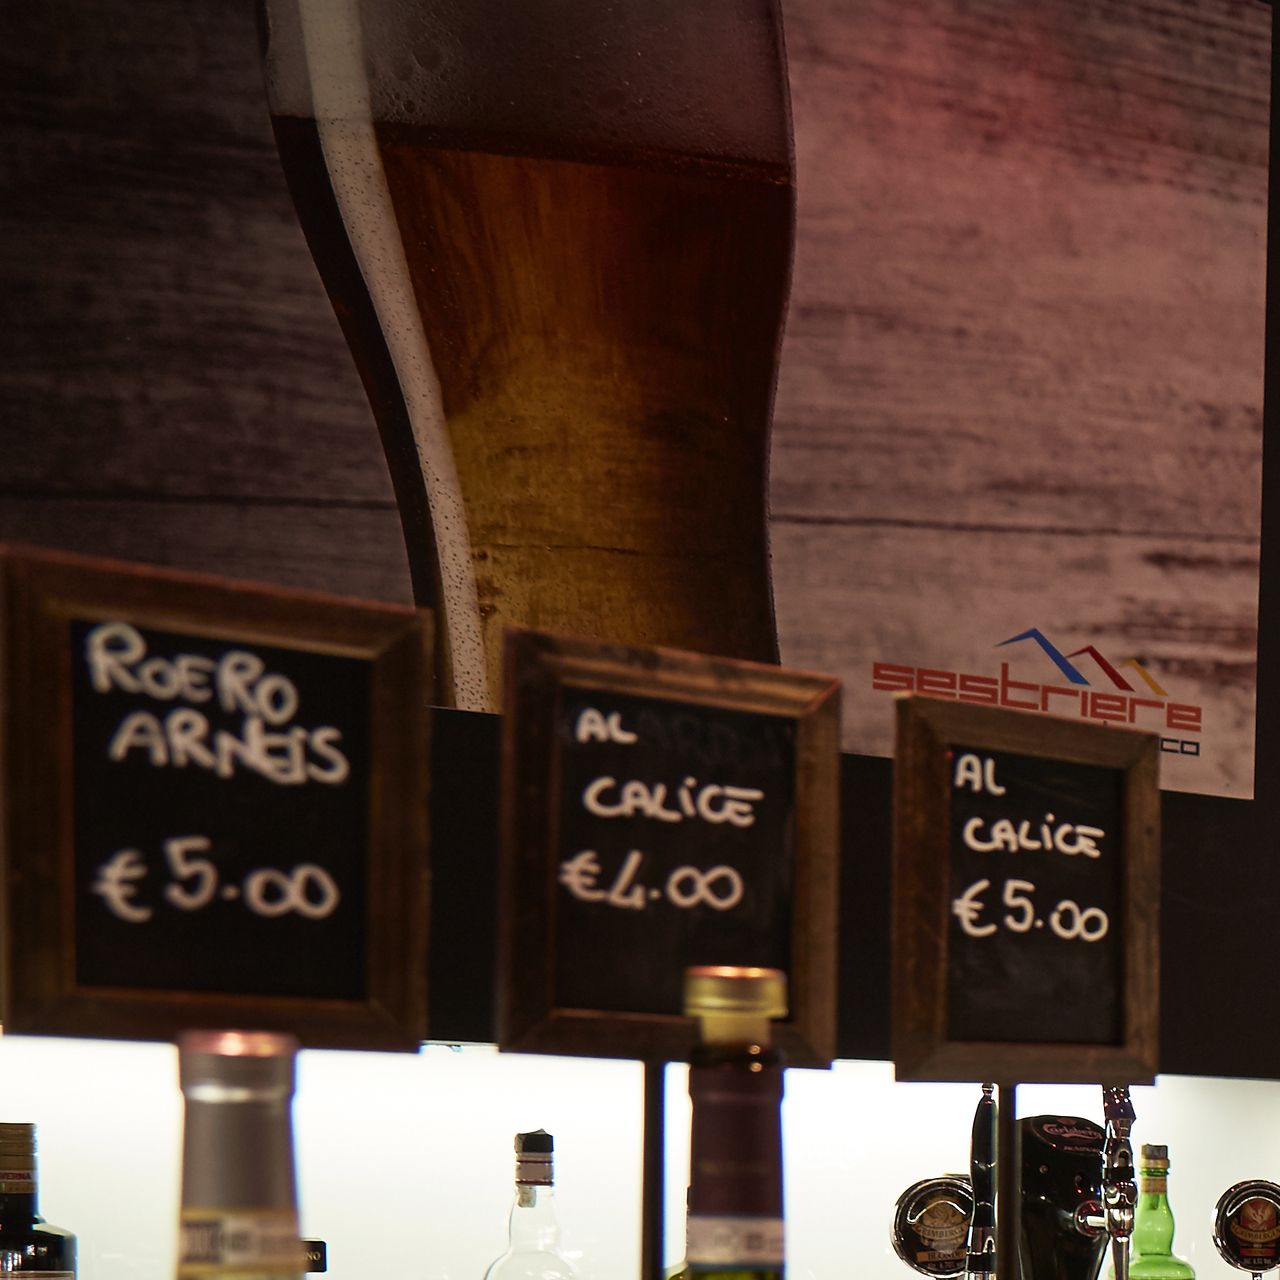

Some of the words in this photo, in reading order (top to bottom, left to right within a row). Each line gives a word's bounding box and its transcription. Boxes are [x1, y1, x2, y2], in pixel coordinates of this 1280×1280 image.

[86, 621, 299, 726] ROERO
[872, 661, 1202, 732] sestriere
[575, 707, 638, 745] AL
[582, 770, 765, 827] CALICE
[955, 753, 1007, 796] AL
[962, 813, 1106, 859] CALICE
